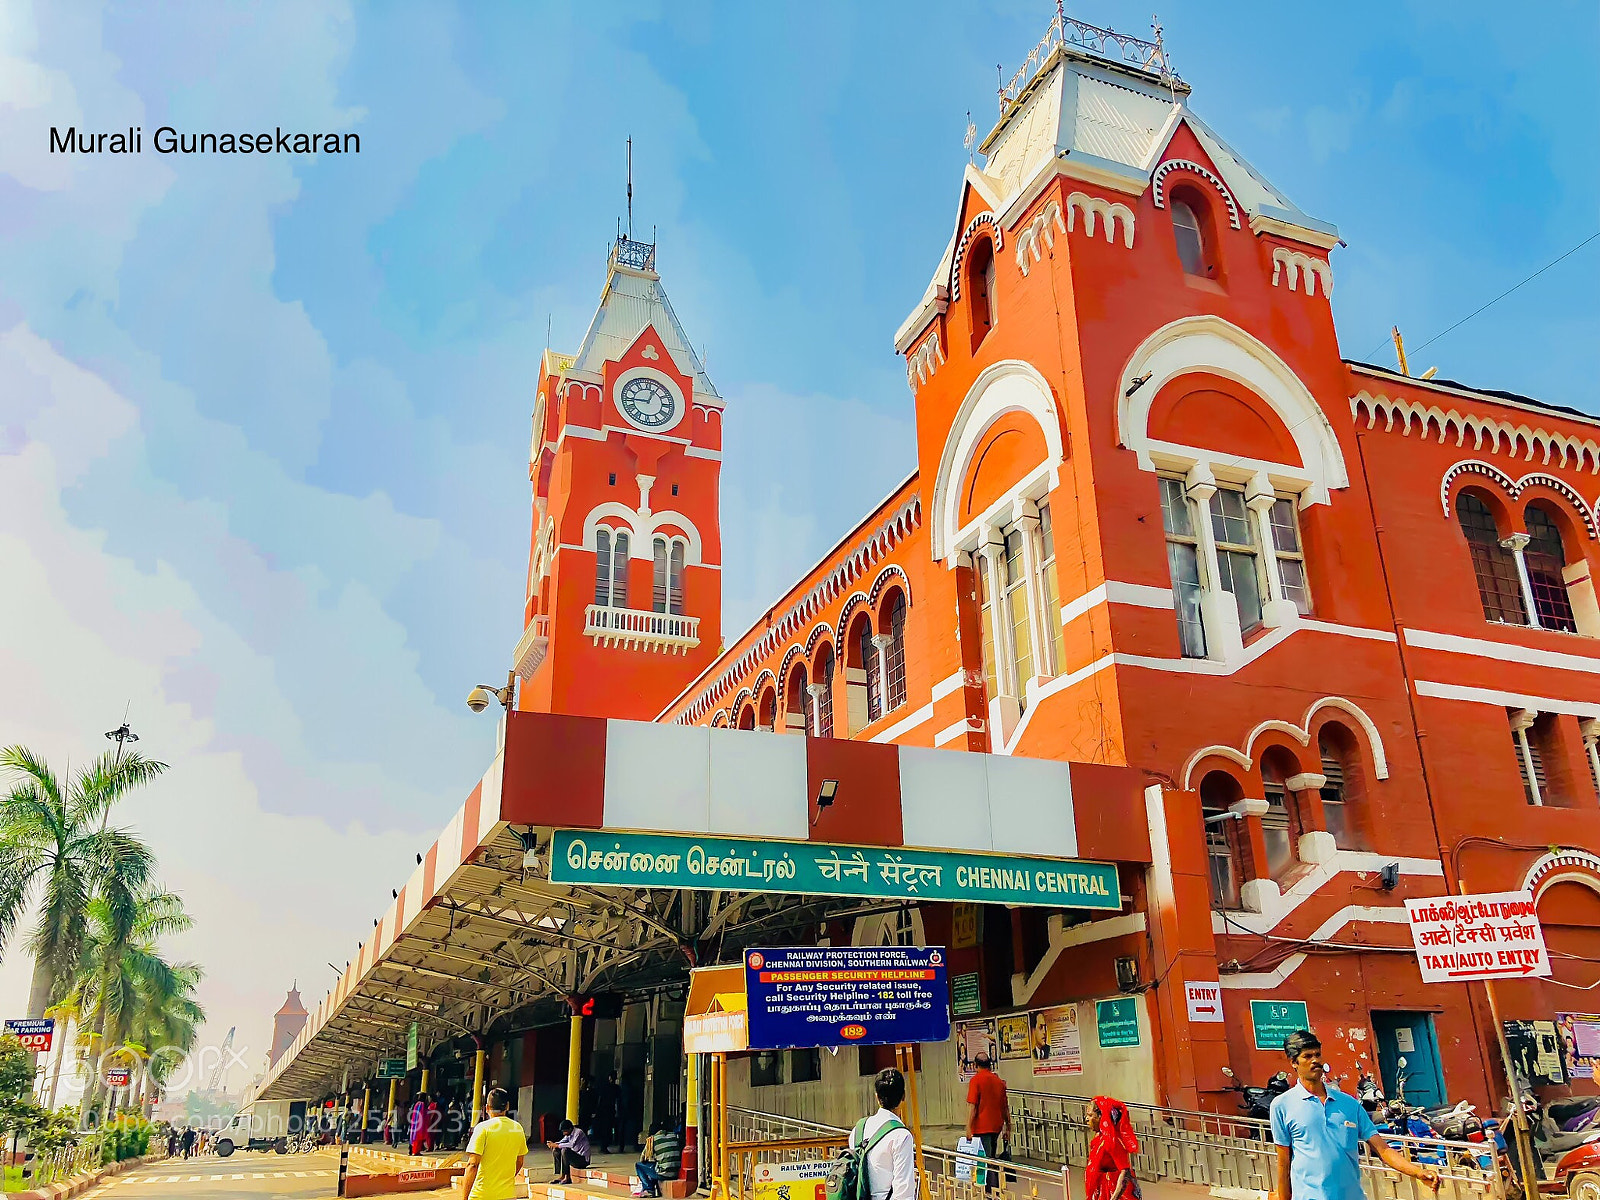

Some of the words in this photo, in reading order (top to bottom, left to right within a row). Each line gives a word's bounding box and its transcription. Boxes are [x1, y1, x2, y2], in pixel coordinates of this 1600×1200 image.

[567, 840, 680, 874] சென்னை
[687, 845, 795, 882] சென்ட்ரல்
[814, 851, 870, 883] चेन्नै
[876, 854, 942, 893] सेंट्रल
[956, 866, 1030, 891] CHENNAI
[1036, 872, 1109, 896] CENTRAL
[1498, 920, 1536, 942] प्रवेश
[806, 960, 846, 968] DIVISION,
[1423, 952, 1494, 970] TAXI/AUTO
[1497, 949, 1540, 966] ENTRY
[795, 984, 813, 992] Any
[816, 983, 856, 992] Security
[894, 982, 922, 990] issue,
[765, 994, 783, 1002] call
[786, 993, 827, 1002] Security
[830, 992, 869, 1001] Helpline
[1189, 988, 1217, 1000] ENTRY
[1282, 1008, 1287, 1017] P
[843, 1027, 863, 1036] 182
[410, 1171, 434, 1179] PARKING
